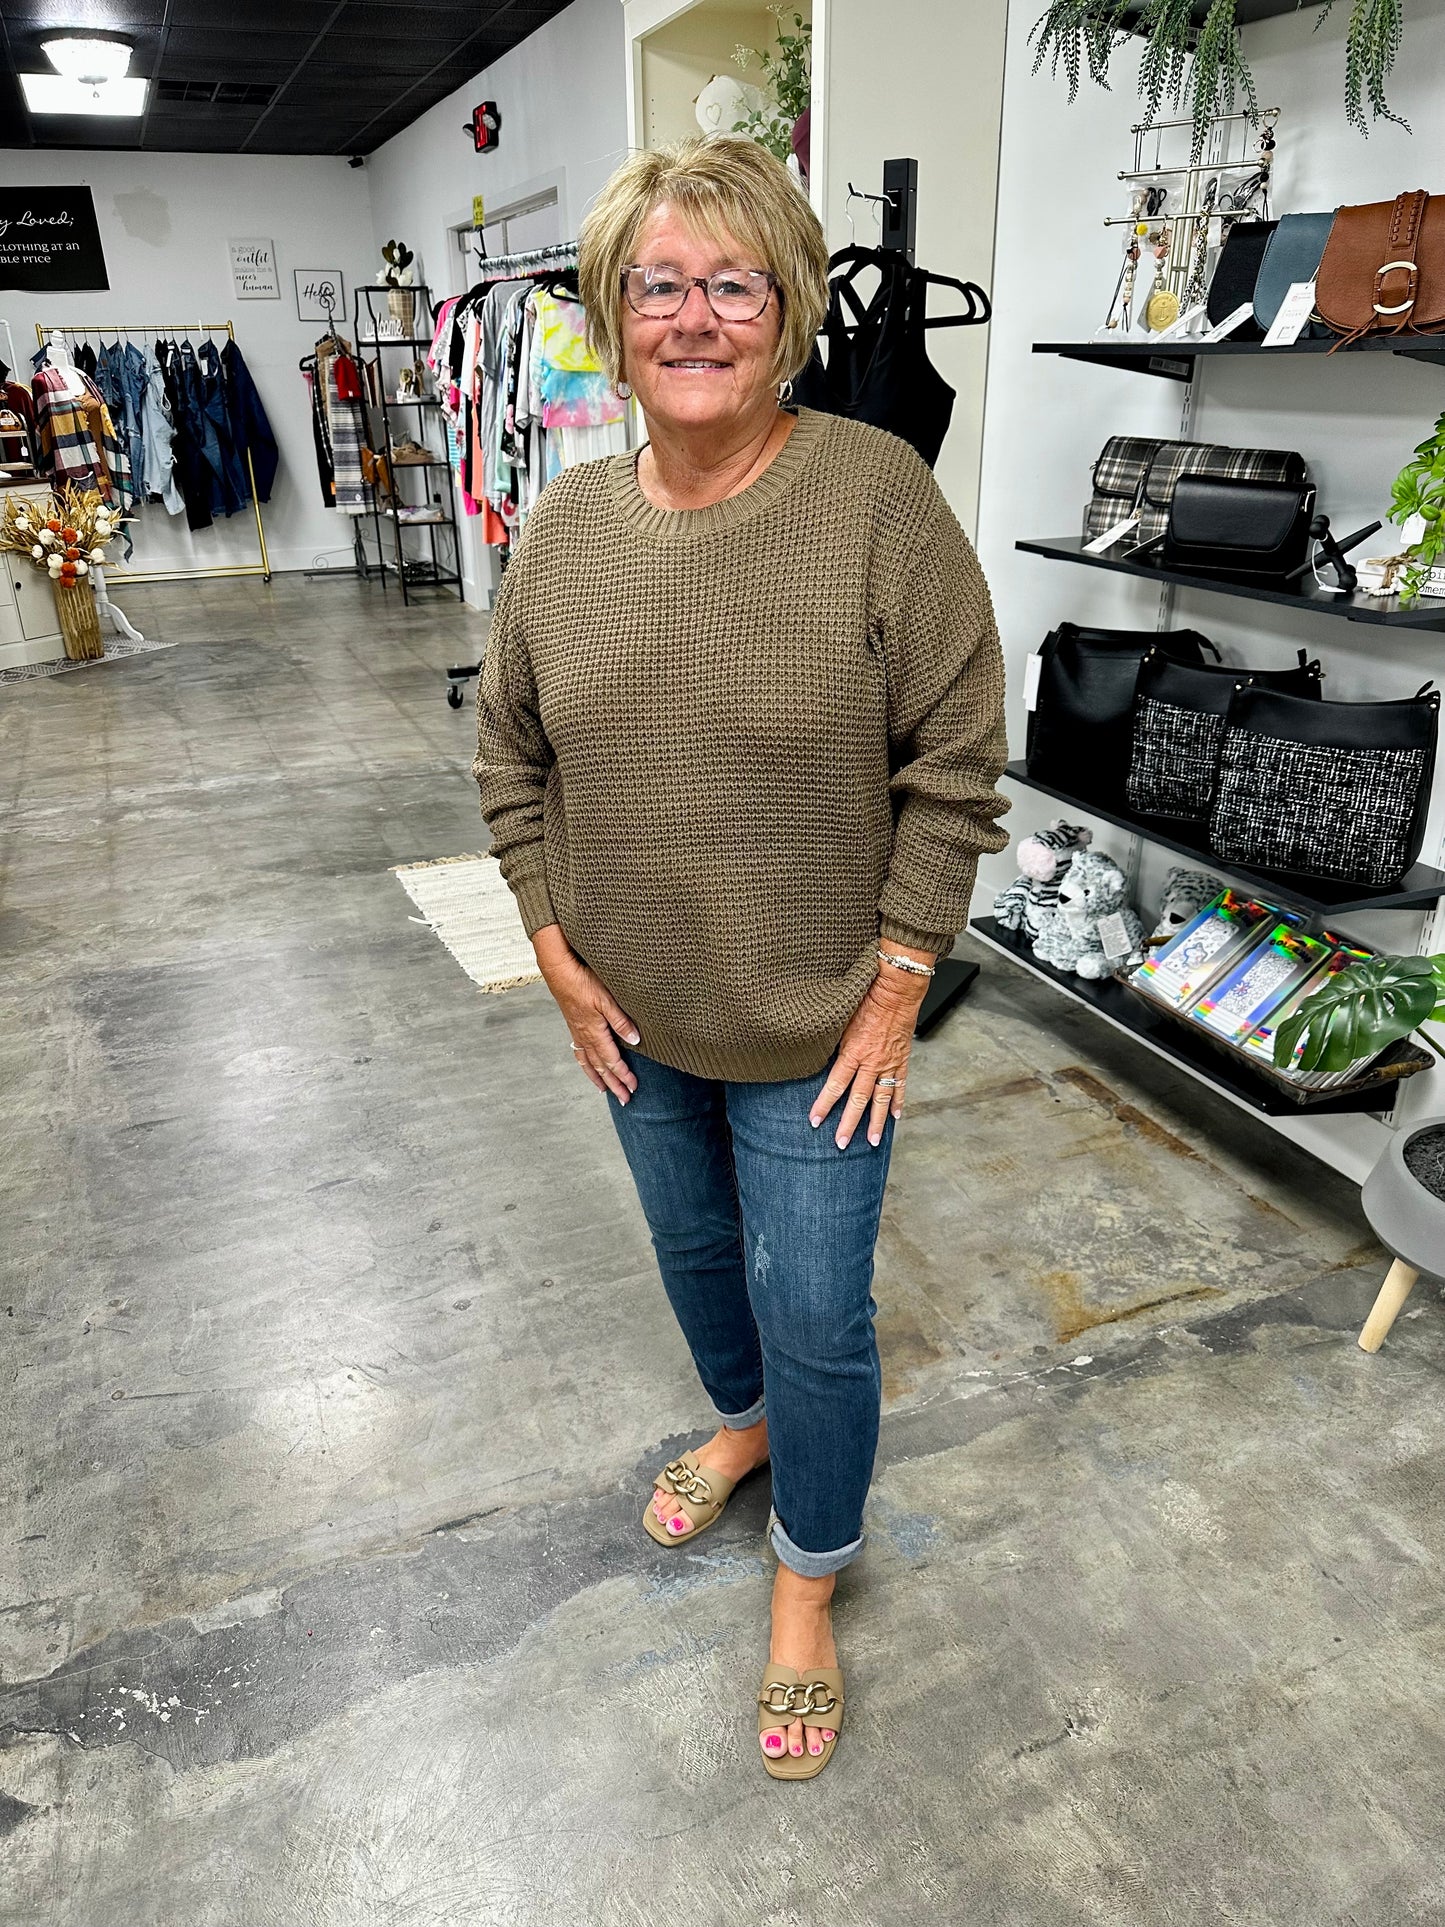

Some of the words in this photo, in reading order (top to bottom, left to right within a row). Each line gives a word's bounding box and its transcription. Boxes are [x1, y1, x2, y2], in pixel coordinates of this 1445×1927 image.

[16, 210, 75, 227] Loved;
[236, 249, 268, 267] outfit
[242, 281, 273, 291] human
[365, 312, 404, 337] wlcome
